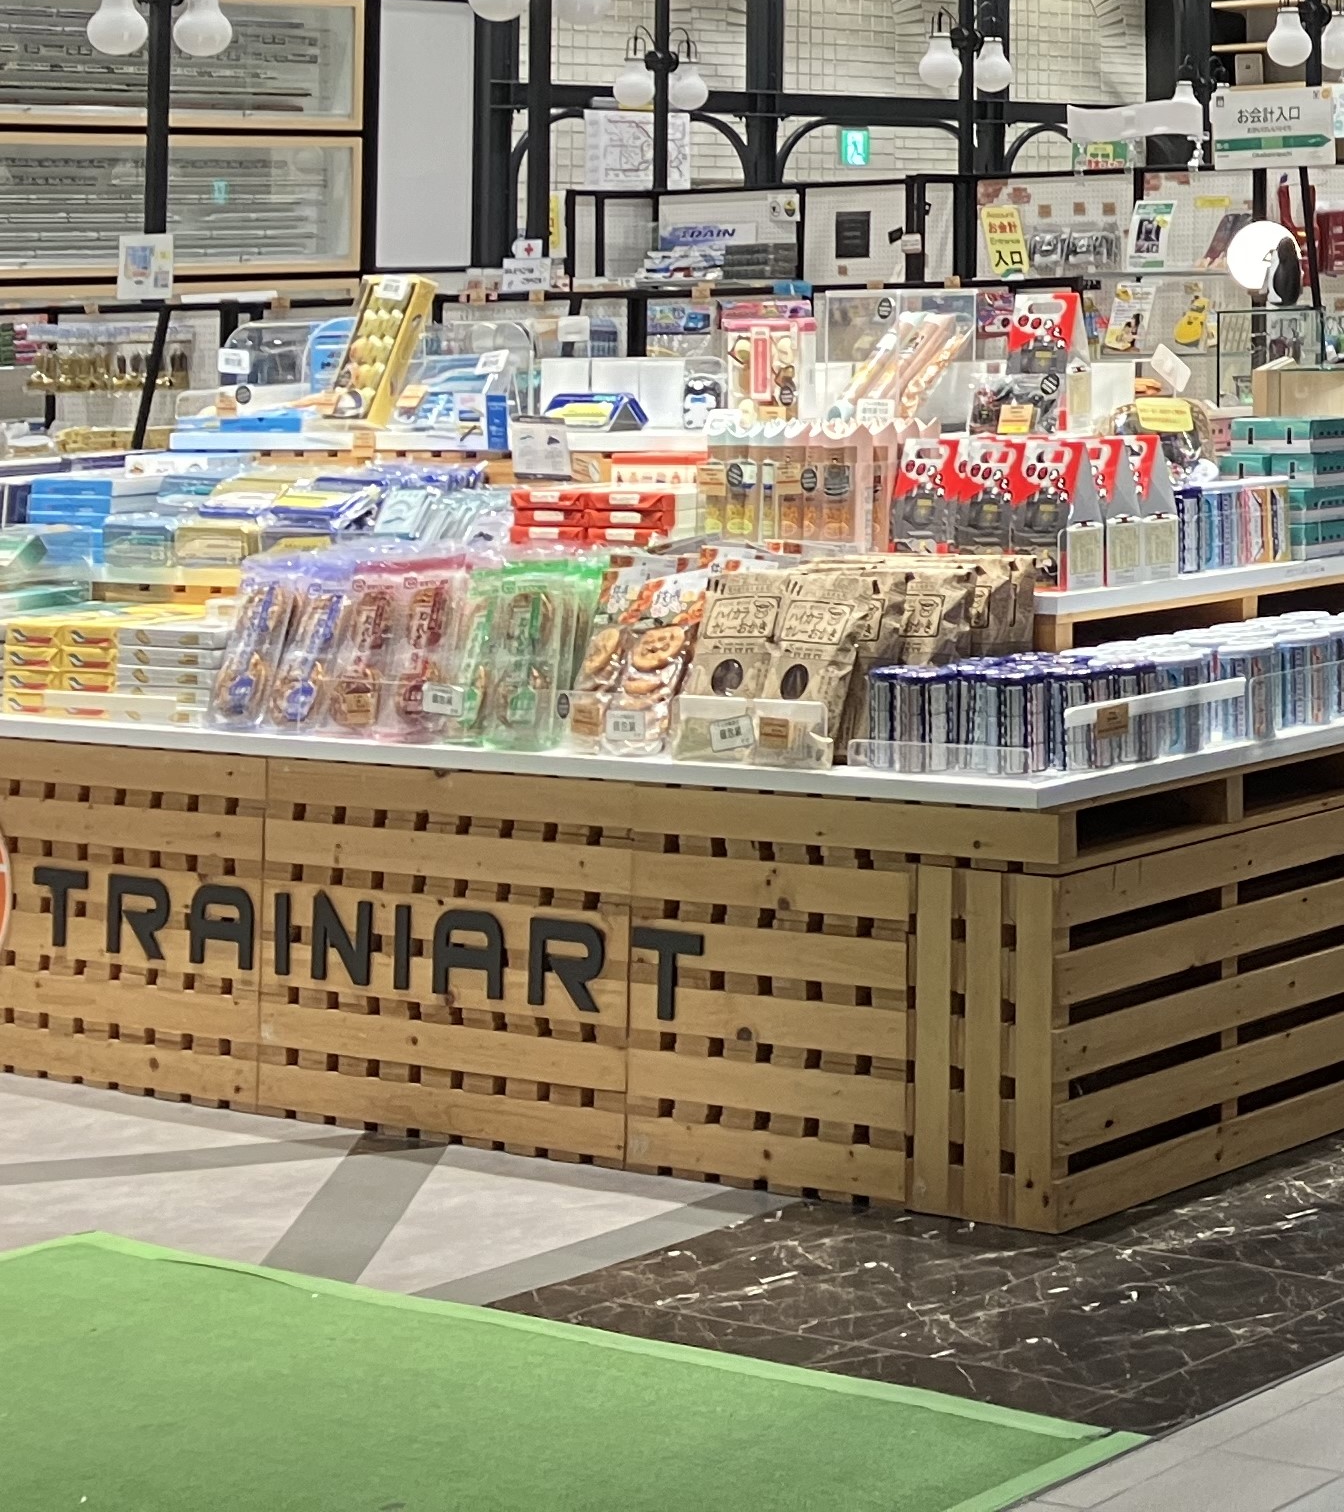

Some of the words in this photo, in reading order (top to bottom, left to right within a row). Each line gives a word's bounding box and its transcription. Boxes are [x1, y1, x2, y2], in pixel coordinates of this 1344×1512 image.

[1237, 106, 1300, 124] お会計入口
[988, 221, 1018, 234] お会計
[994, 249, 1024, 268] 入口
[32, 865, 705, 1021] TRAINIART
